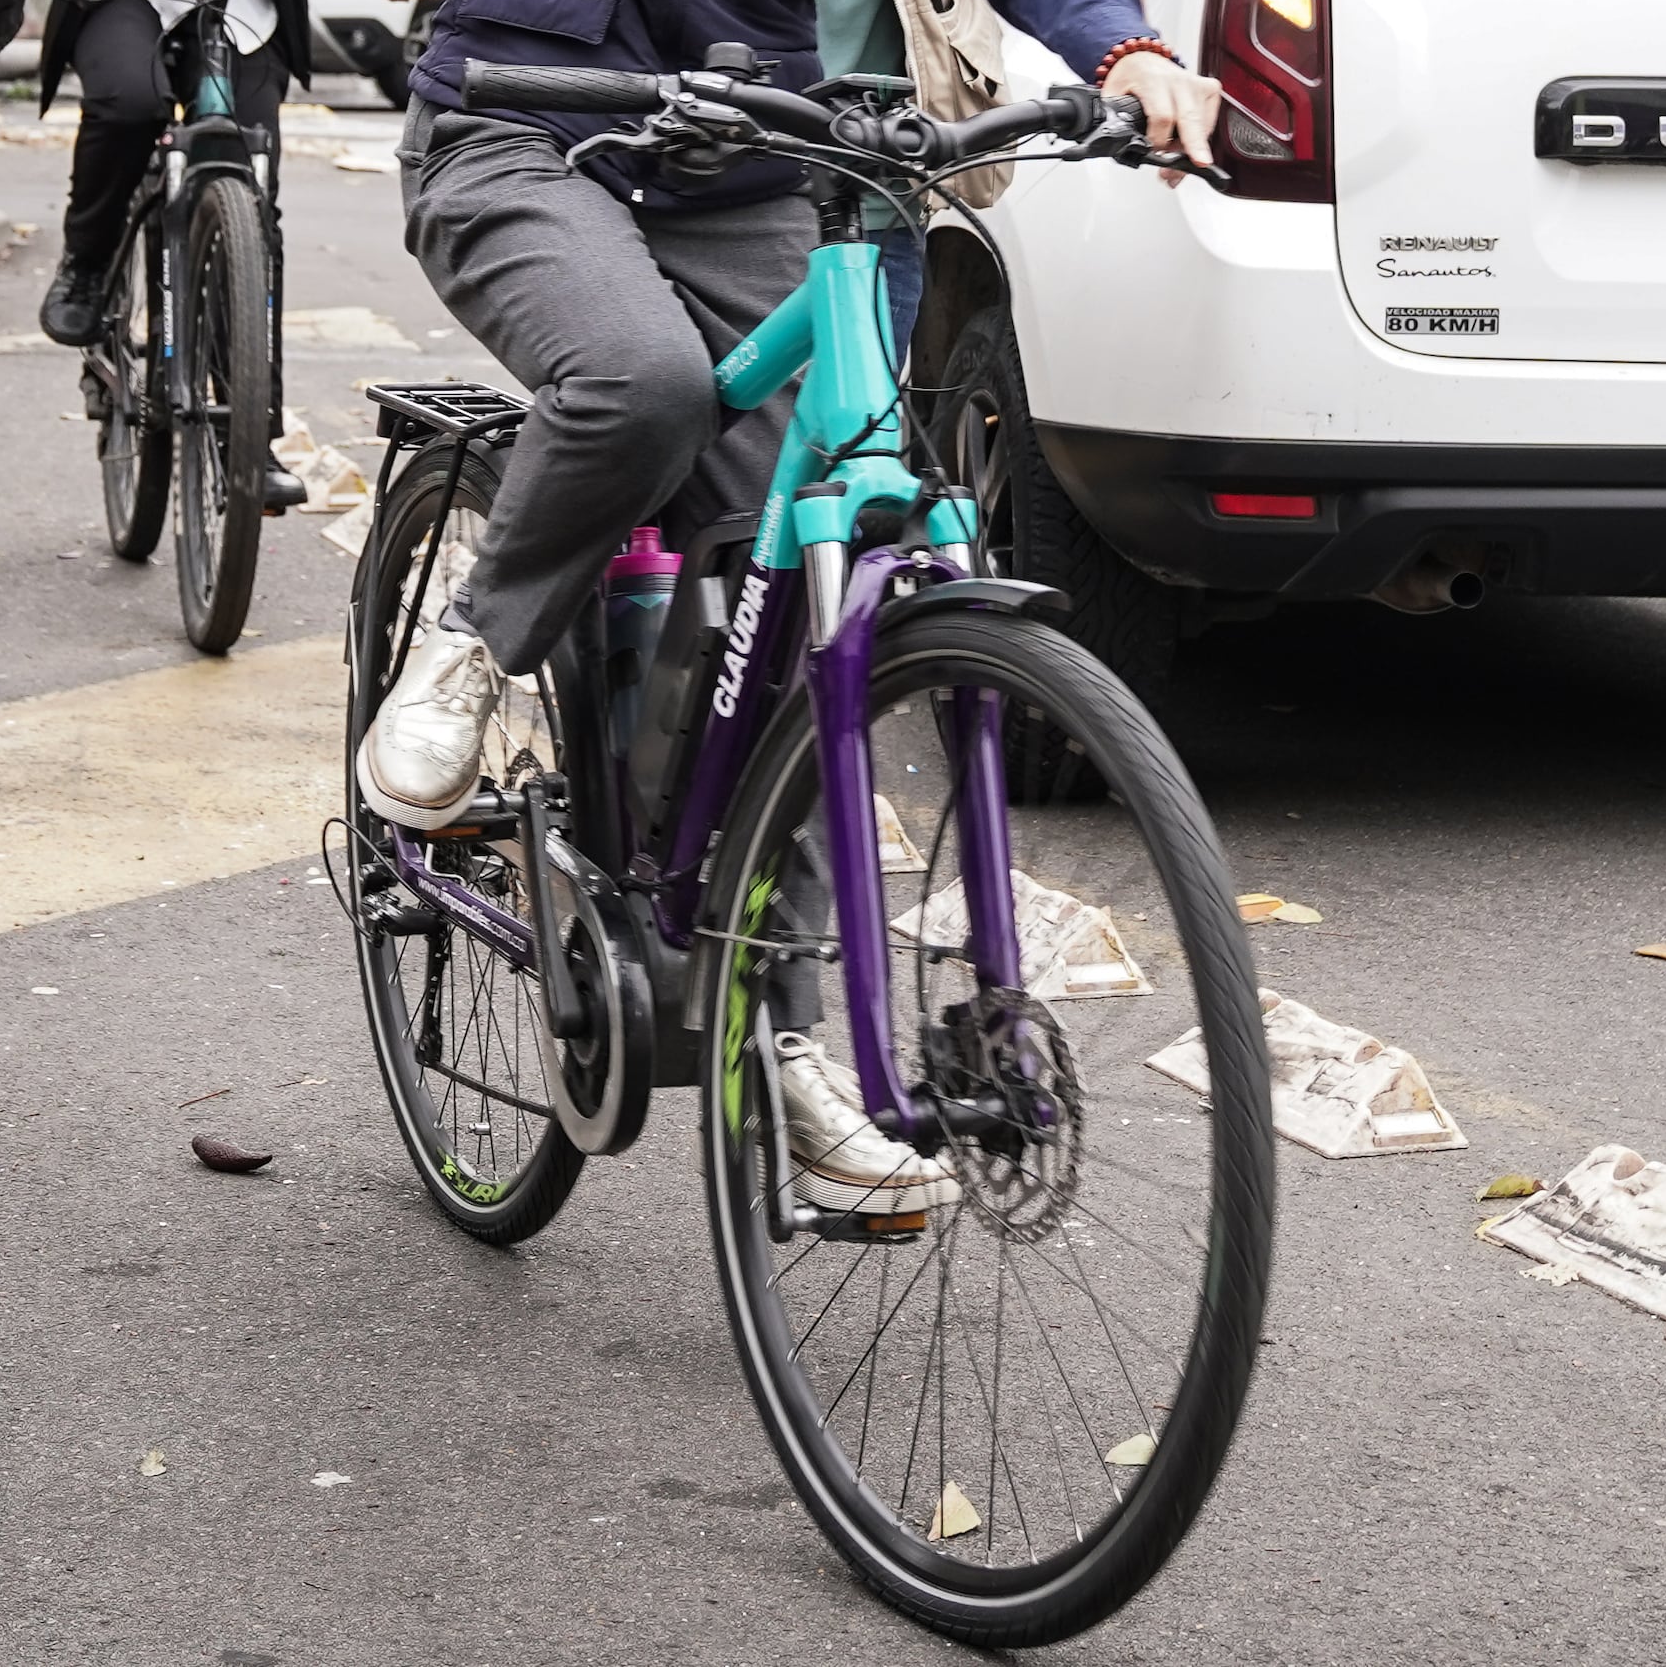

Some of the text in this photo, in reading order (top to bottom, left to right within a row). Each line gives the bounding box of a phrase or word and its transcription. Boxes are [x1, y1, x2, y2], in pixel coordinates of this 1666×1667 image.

[1379, 235, 1500, 252] RENAULT
[1386, 307, 1499, 317] VELOCIDAD MAXIMA
[1388, 317, 1496, 333] 80 KM/H
[713, 573, 770, 718] CLAUDIA
